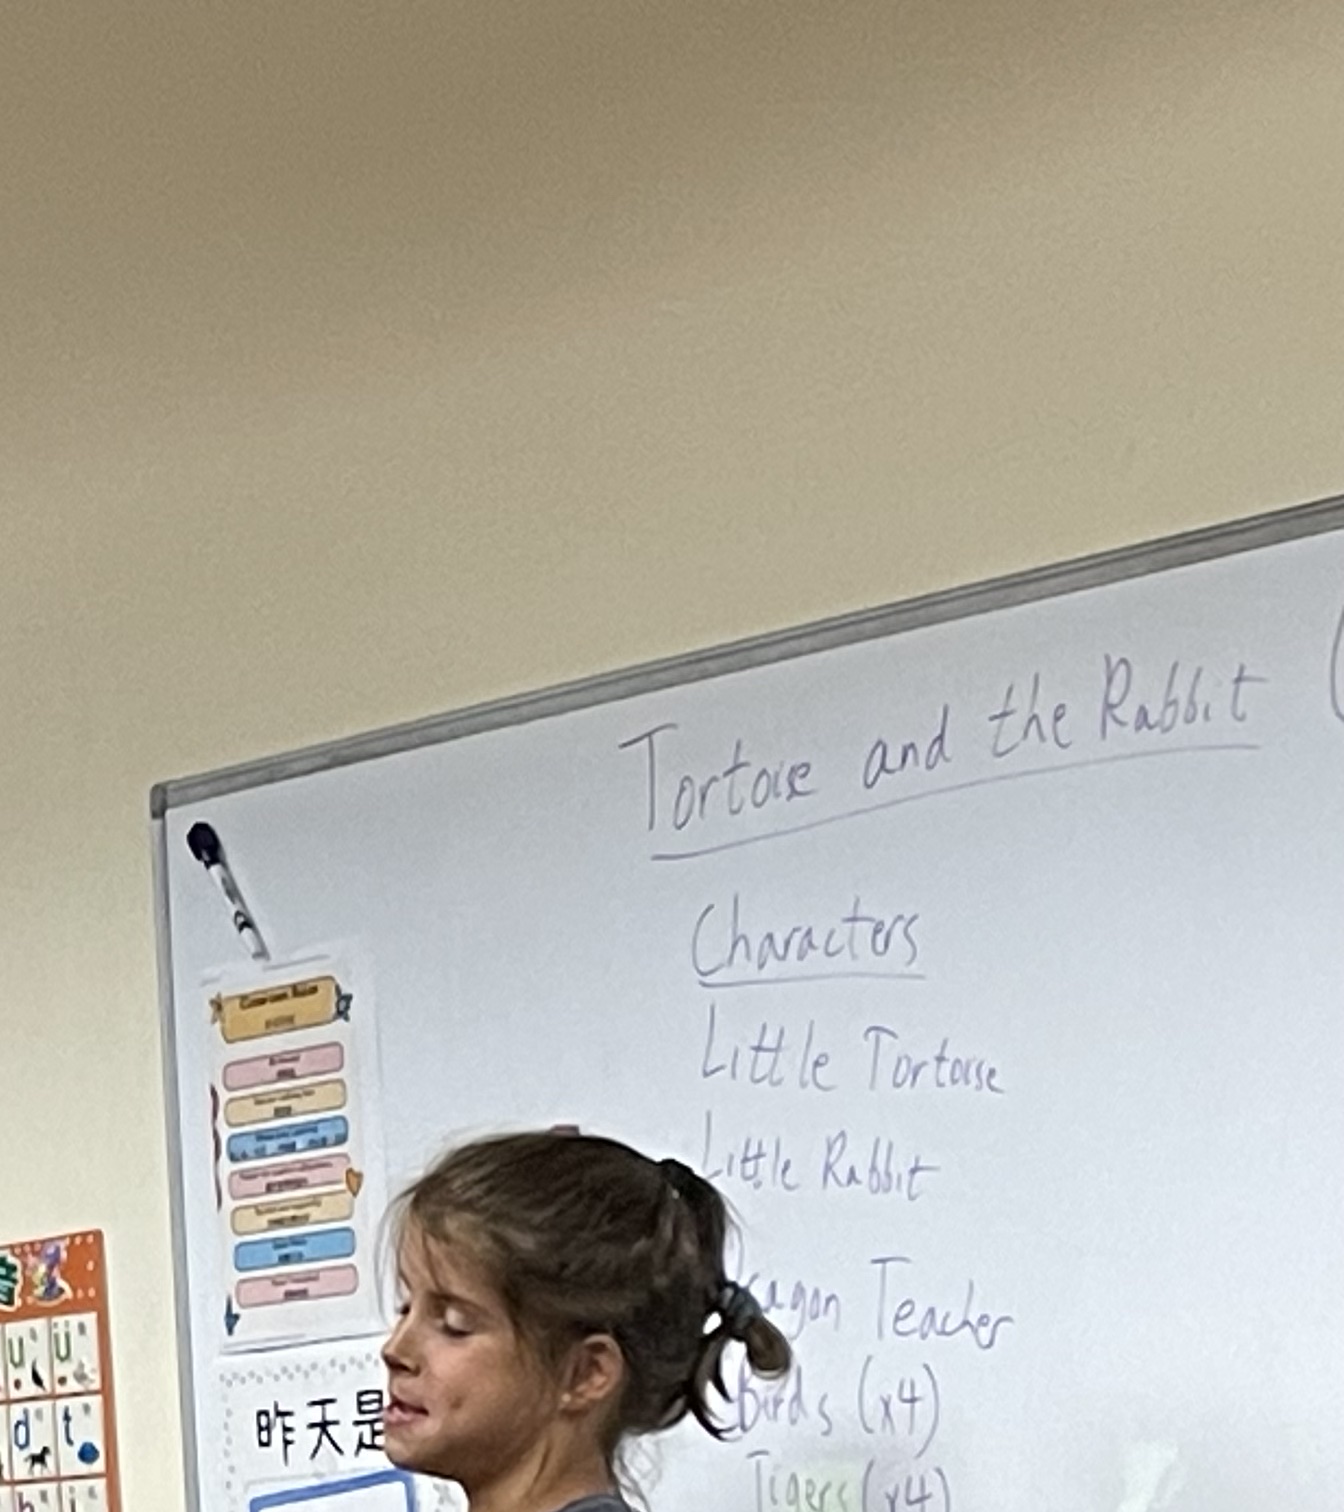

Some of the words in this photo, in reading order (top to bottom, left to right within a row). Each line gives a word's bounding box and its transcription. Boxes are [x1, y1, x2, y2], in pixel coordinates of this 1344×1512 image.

[862, 704, 952, 789] and
[988, 673, 1072, 759] the
[1101, 653, 1268, 742] Rabbit
[692, 893, 919, 977] Characters
[702, 1002, 837, 1091] Little
[864, 1025, 1005, 1094] Tortoise
[702, 1110, 799, 1191] Little
[822, 1129, 940, 1201] Rabbit
[8, 1335, 24, 1368] u
[53, 1321, 71, 1362] ü
[870, 1257, 1014, 1350] Teacher
[14, 1408, 29, 1450] d
[63, 1405, 74, 1446] t
[256, 1389, 384, 1467] 昨天是
[736, 1364, 833, 1436] Birds
[858, 1355, 940, 1458] (x4)
